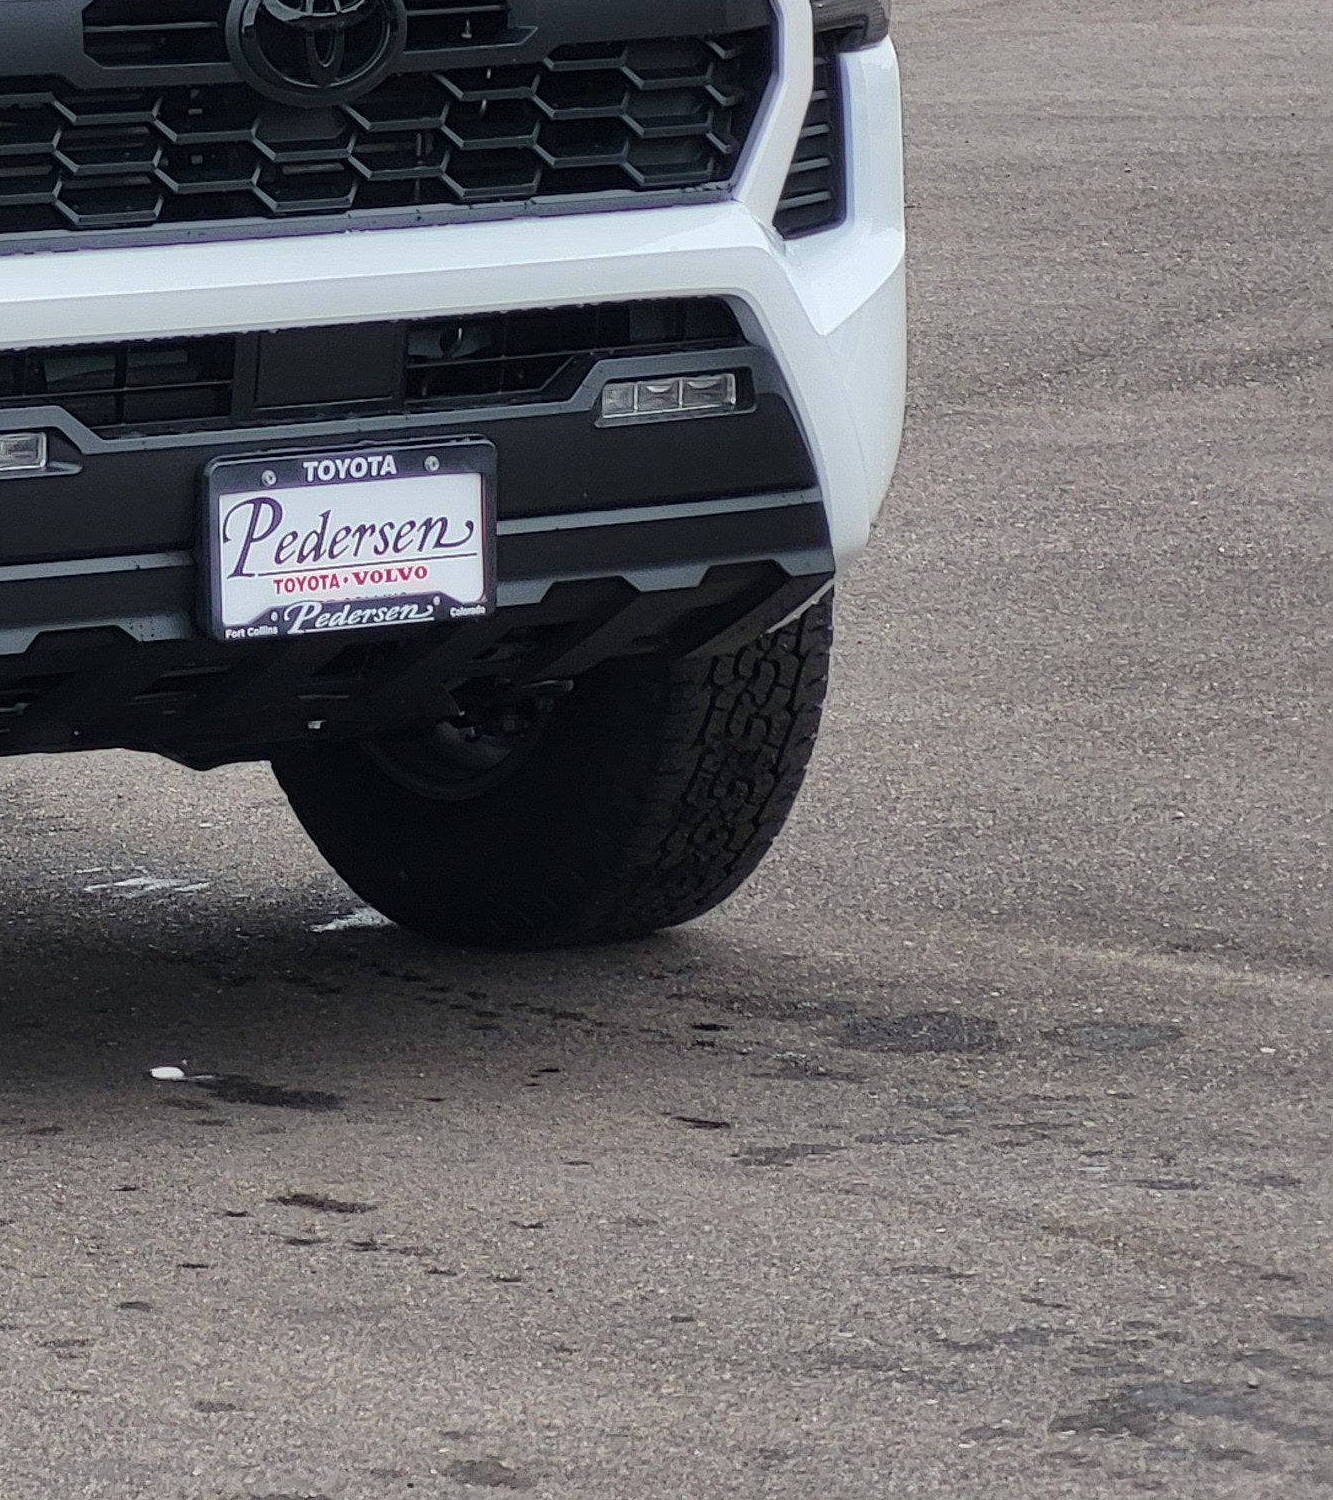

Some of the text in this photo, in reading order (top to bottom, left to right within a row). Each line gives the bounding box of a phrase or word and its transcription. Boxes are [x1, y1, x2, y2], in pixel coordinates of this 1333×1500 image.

[303, 455, 398, 482] TOYOTA
[223, 496, 475, 579] Pedersen
[273, 565, 428, 595] TOYOTA VOLVO
[284, 601, 434, 635] Pedersen
[450, 606, 486, 618] Colorado
[225, 625, 279, 640] Fort Collins
